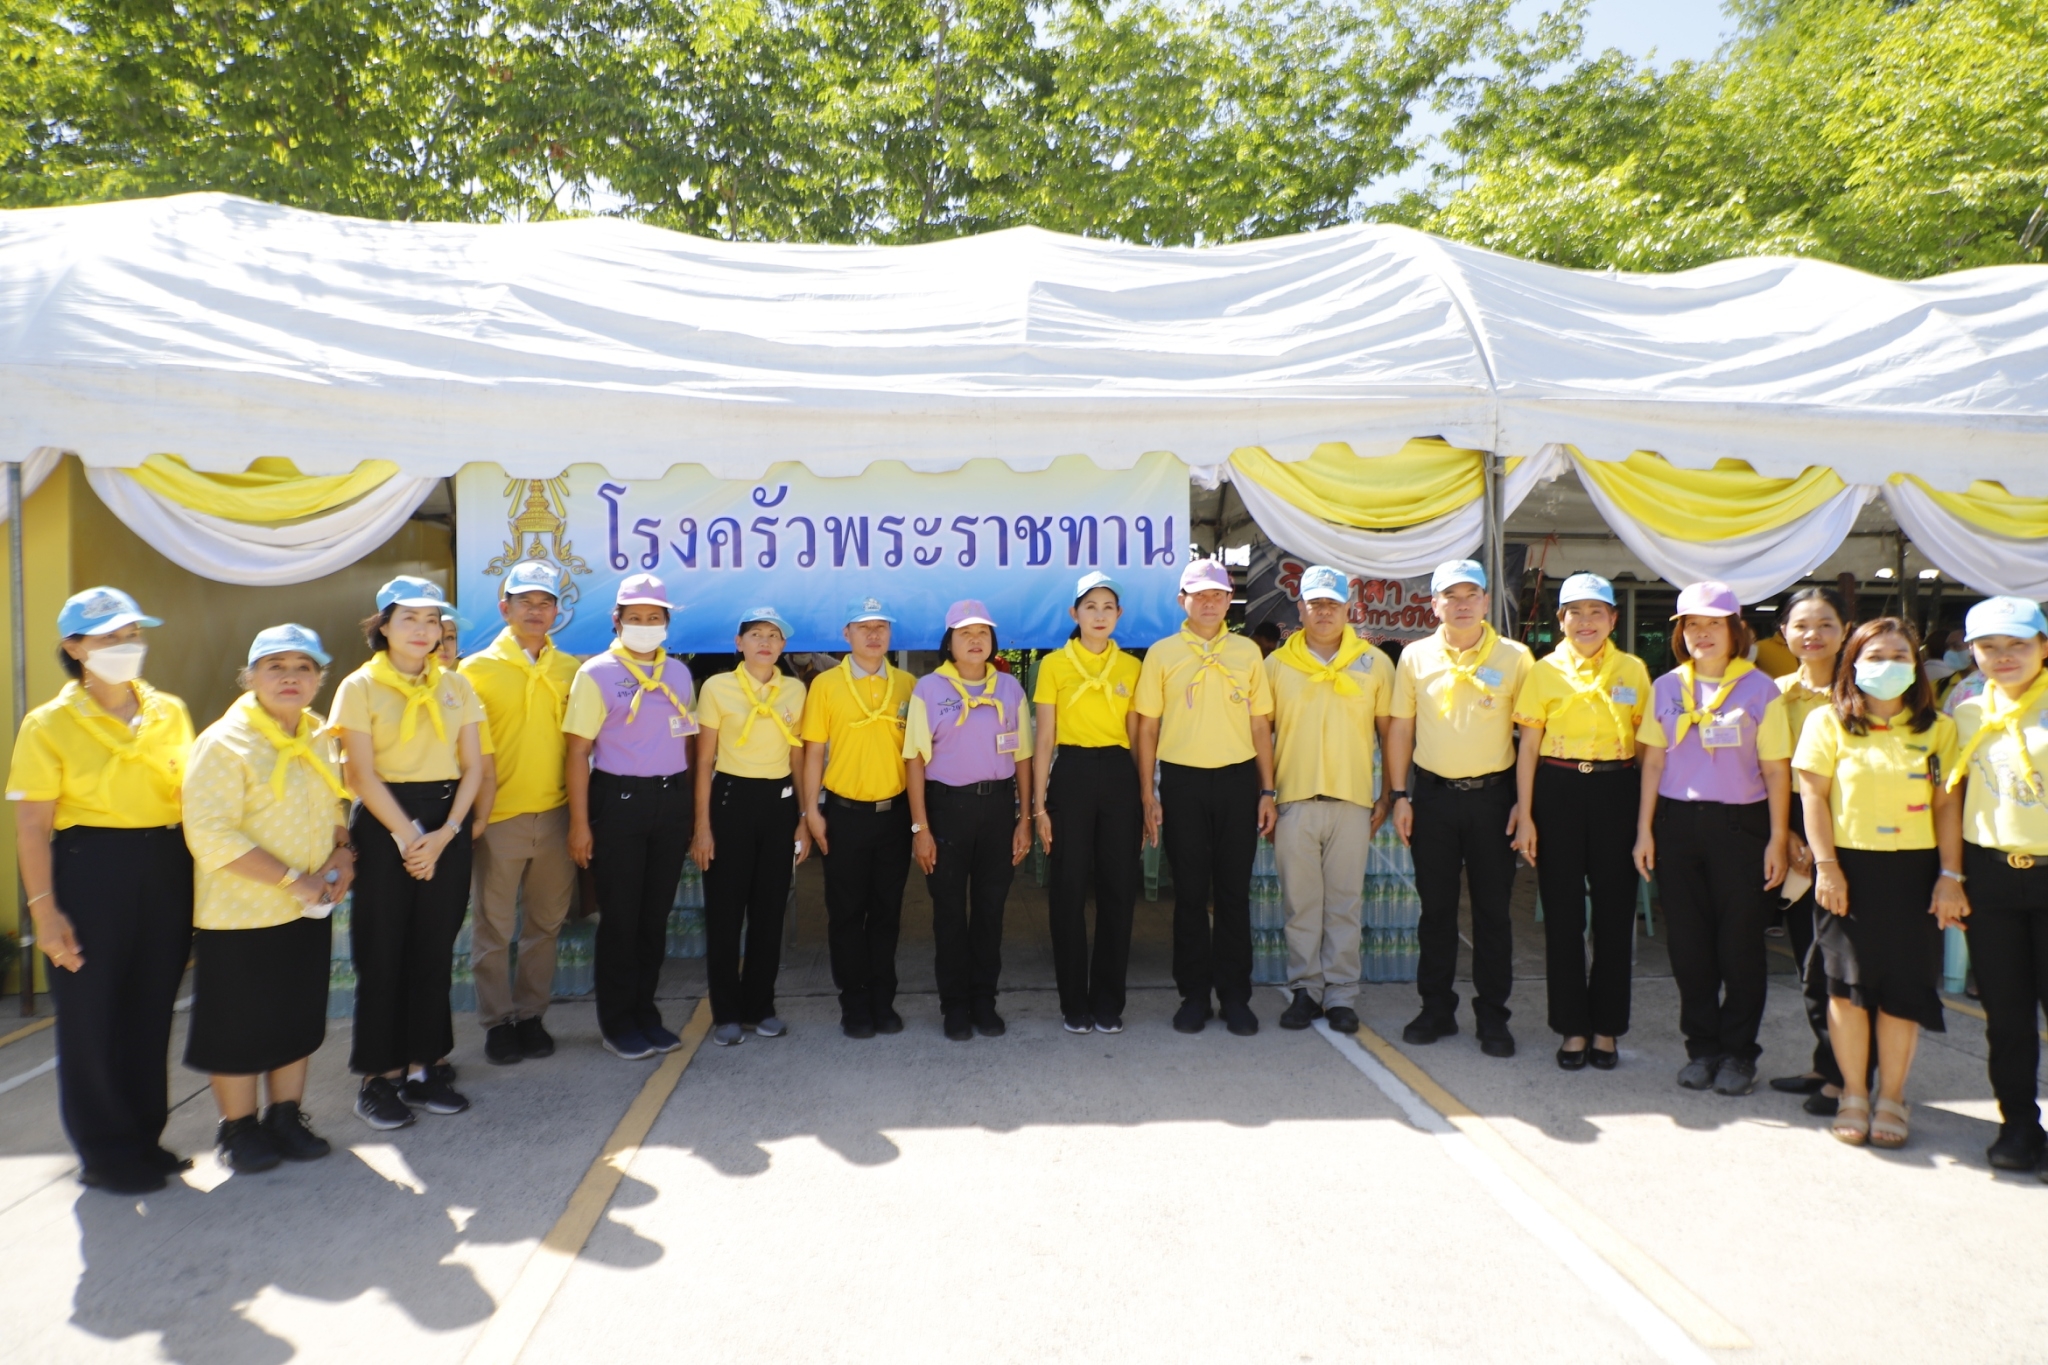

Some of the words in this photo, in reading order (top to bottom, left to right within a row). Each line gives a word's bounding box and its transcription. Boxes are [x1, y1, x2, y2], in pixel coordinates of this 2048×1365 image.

[597, 482, 1175, 571] โรงครัวพระราชทาน
[1279, 562, 1402, 605] จิาสา
